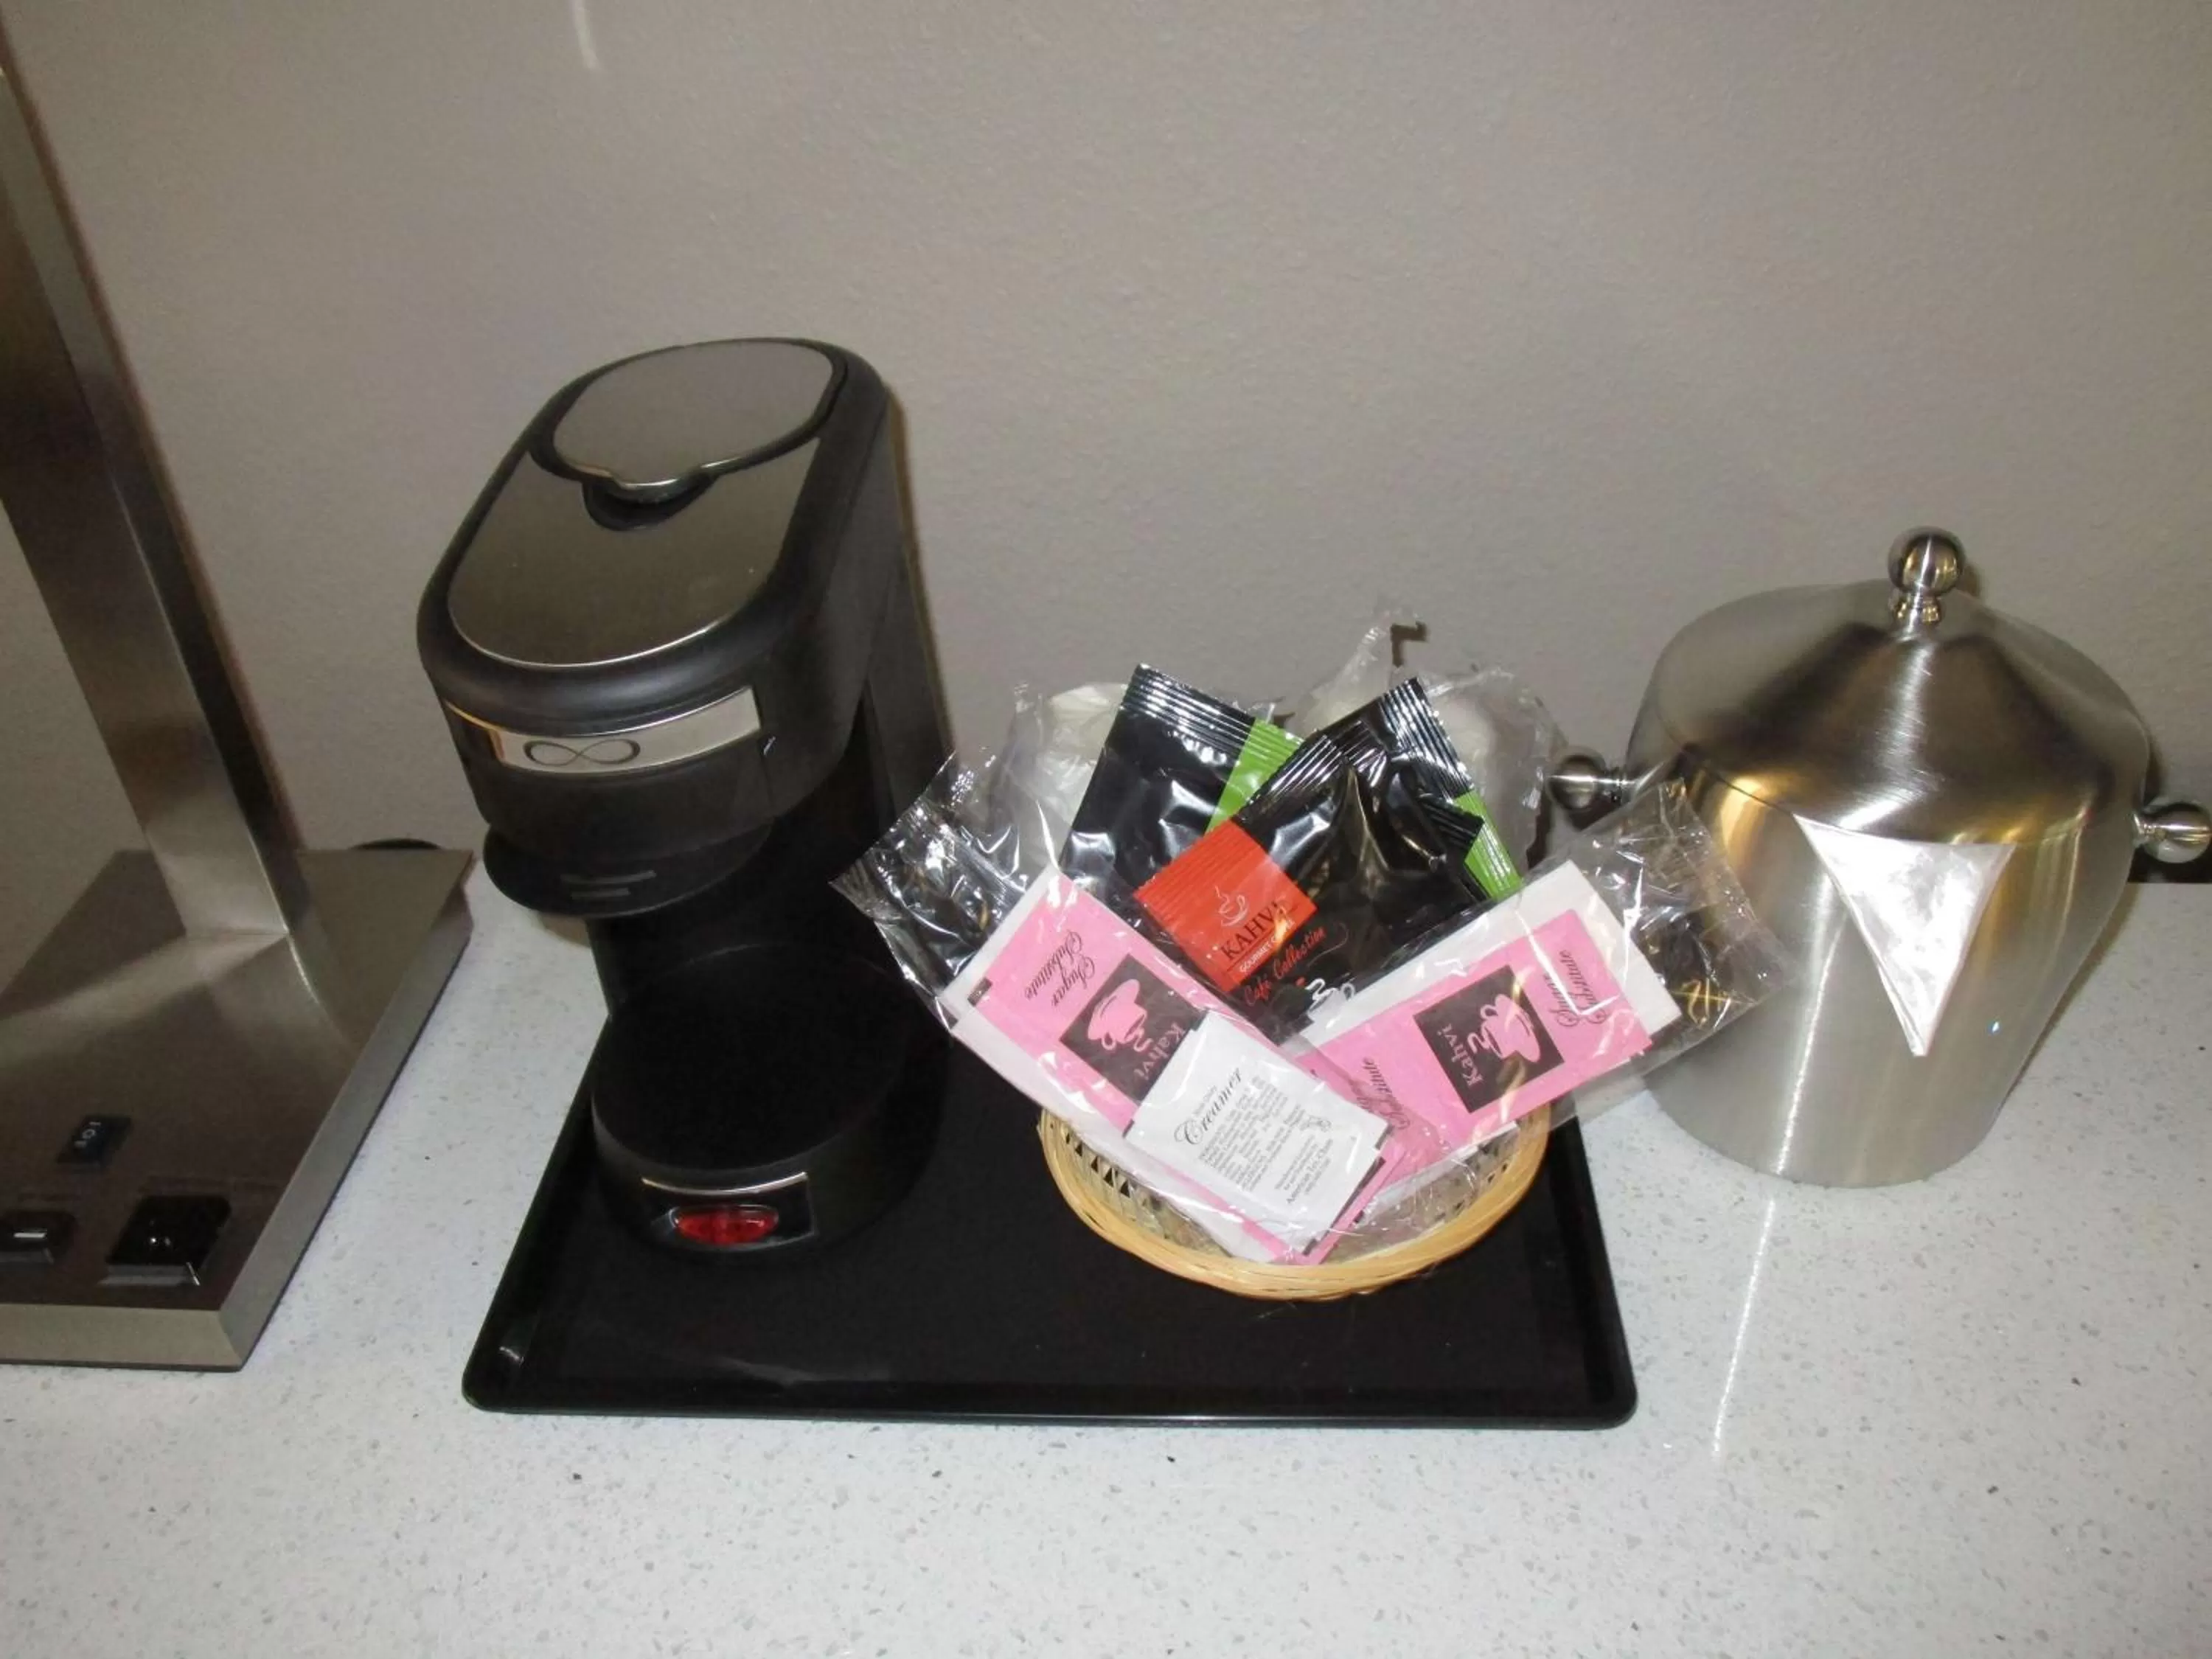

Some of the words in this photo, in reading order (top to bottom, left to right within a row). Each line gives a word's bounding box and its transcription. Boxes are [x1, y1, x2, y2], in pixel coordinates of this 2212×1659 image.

[1024, 930, 1082, 1001] Substitute
[1051, 954, 1095, 1006] Sugar
[1134, 1022, 1186, 1080] Kahvi
[1436, 1023, 1484, 1086] Kahvi
[1173, 1067, 1242, 1145] Creamer
